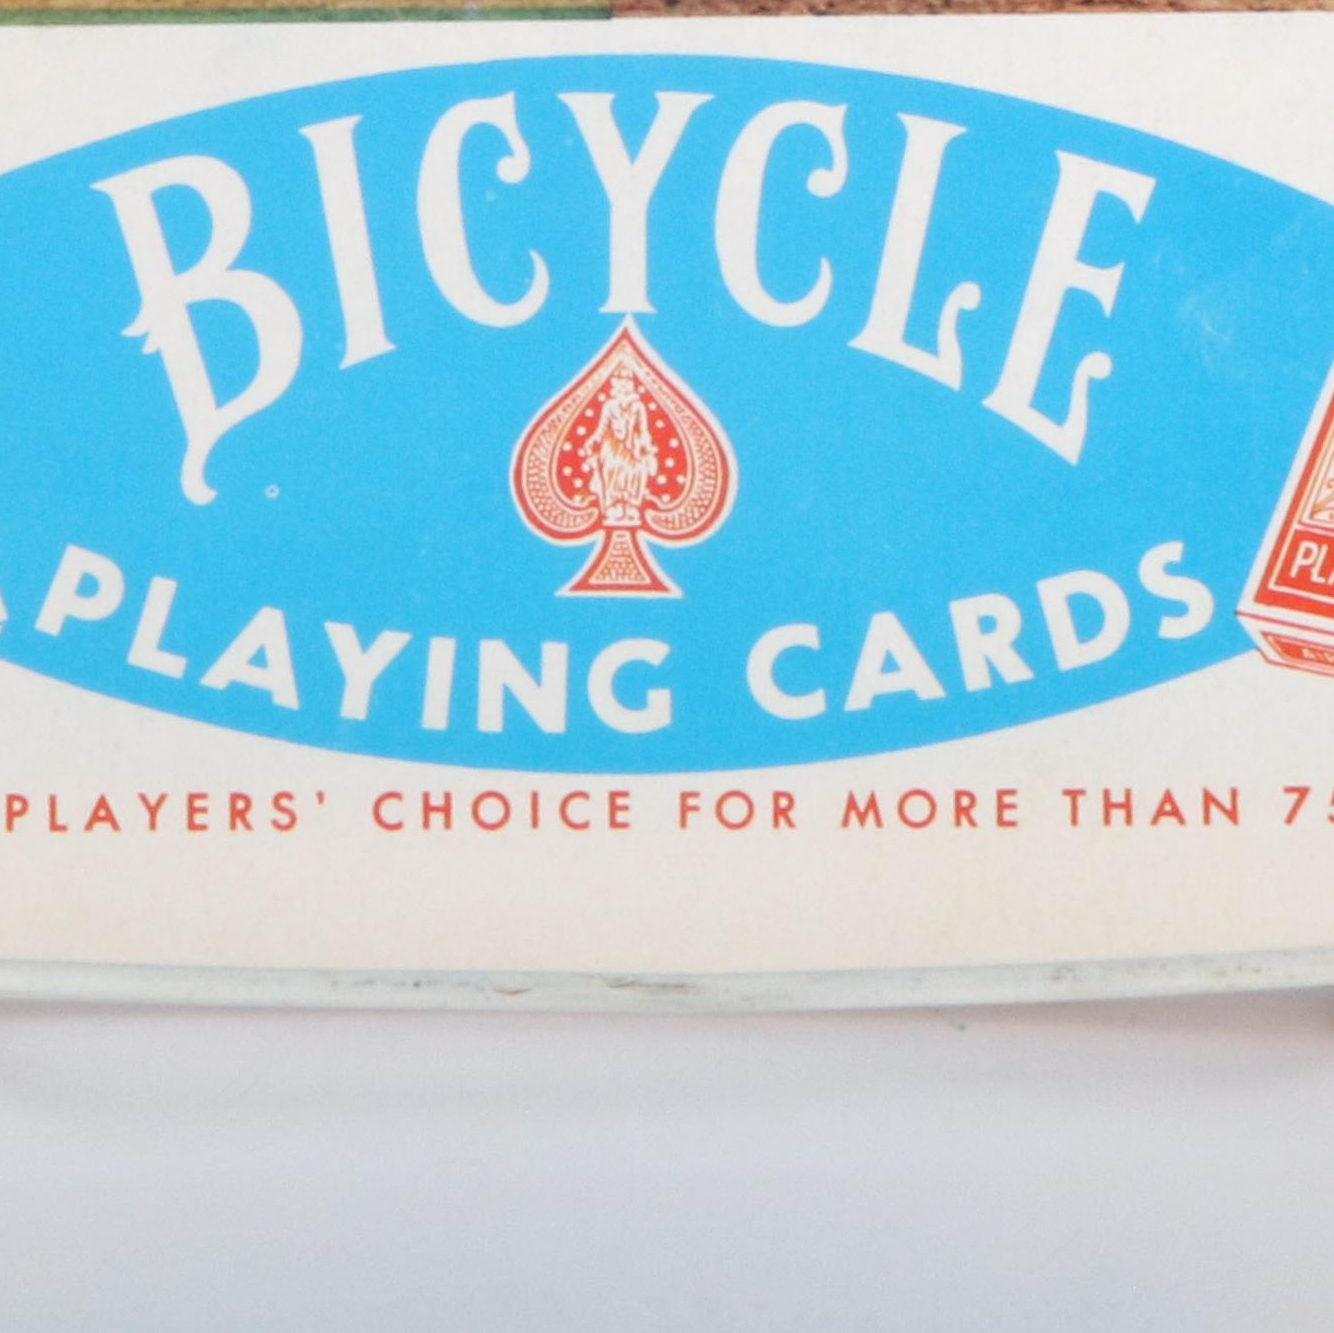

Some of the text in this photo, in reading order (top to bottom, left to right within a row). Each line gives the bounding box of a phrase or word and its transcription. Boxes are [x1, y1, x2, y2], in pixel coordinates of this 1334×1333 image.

[89, 90, 1157, 506] BICYCLE
[33, 539, 1217, 735] PLAYING CARDS
[5, 791, 327, 834] PLAYERS'
[372, 788, 633, 831] CHOICE
[679, 790, 797, 831] FOR
[840, 788, 1020, 830] MORE
[1063, 786, 1242, 826] THAN
